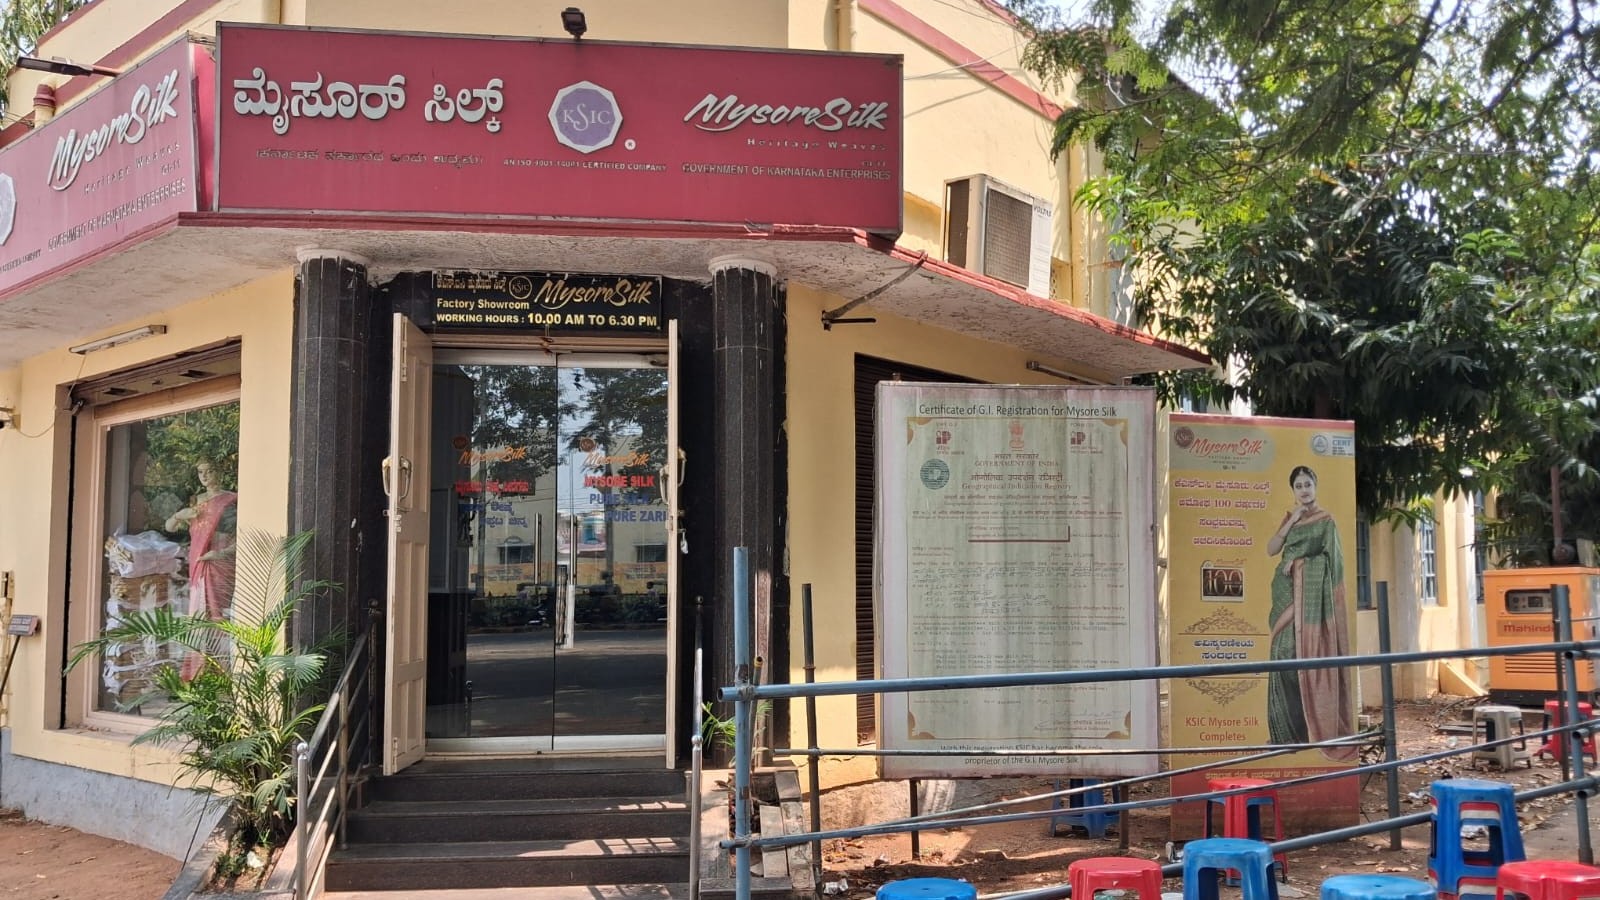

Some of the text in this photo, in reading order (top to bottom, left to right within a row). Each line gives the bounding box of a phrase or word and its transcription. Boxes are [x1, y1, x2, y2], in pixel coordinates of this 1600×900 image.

[233, 67, 504, 134] ಮೈಸೂರ್ ಸಿಲ್ಕ್
[562, 103, 611, 132] KSIC
[747, 138, 820, 149] Heritage
[582, 161, 625, 170] CERTIFIED
[627, 163, 667, 172] COMPANY
[682, 162, 891, 181] GOVERNMENT OF KARNATAKA ENTERPRISES
[437, 299, 530, 310] Factory Showroom
[437, 314, 483, 323] WORKING
[485, 314, 519, 324] HOURS
[527, 313, 561, 325] 10.00
[564, 314, 585, 325] AM
[588, 315, 605, 326] TO
[608, 315, 635, 326] 6.30
[638, 316, 657, 327] PM
[919, 403, 1117, 418] Certificate of G.I. Registration for Mysore Silk
[584, 475, 655, 488] MYSORE SILK
[962, 482, 1072, 491] Geographical Indication Registry
[589, 493, 620, 505] PURE
[1215, 499, 1231, 508] 100
[607, 510, 668, 522] PURE ZARI
[1185, 716, 1259, 728] KSIC Mysore Silk
[1199, 731, 1246, 744] Completes
[965, 757, 1000, 765] proprietor
[1002, 756, 1012, 765] of
[1013, 756, 1023, 764] the
[1038, 756, 1064, 765] Mysore
[1065, 756, 1078, 764] Silk
